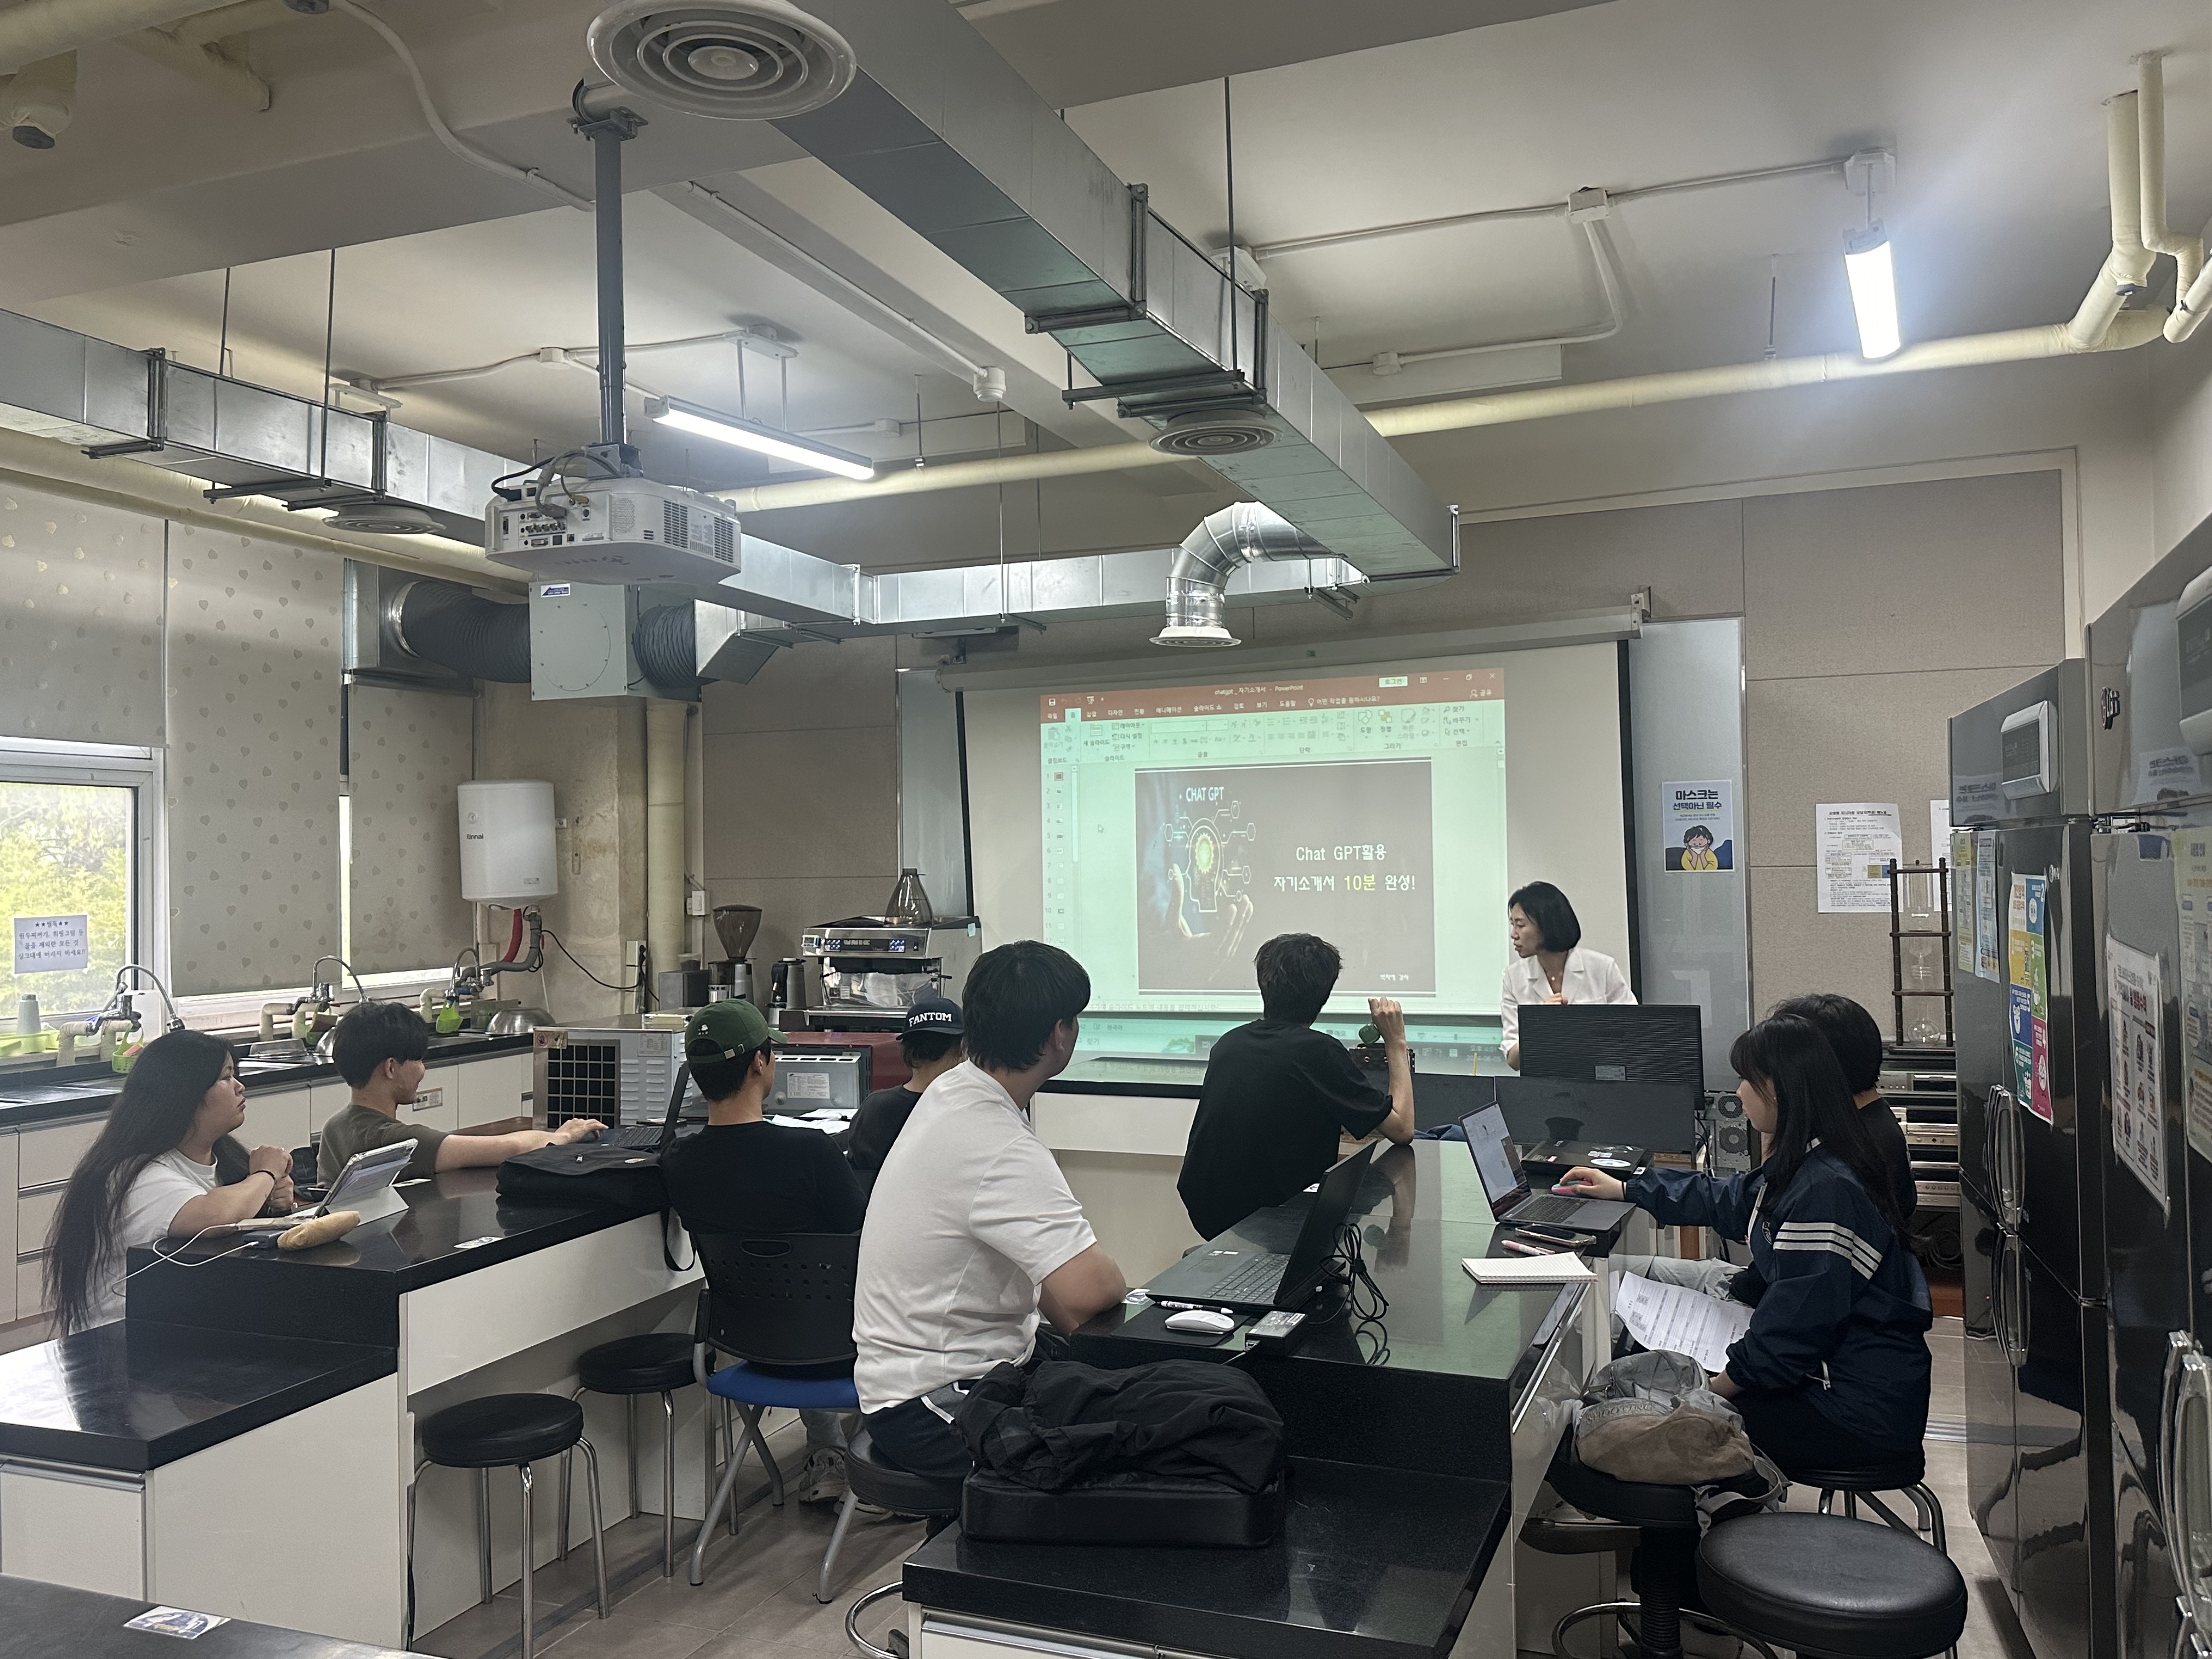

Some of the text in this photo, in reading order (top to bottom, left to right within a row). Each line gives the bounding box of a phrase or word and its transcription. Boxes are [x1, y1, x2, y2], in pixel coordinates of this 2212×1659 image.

[1186, 786, 1224, 802] CHAT GPT
[1675, 789, 1718, 800] 마스크는
[1673, 801, 1722, 810] 선택아닌 필수
[1296, 844, 1386, 861] Chat GPT활용
[1274, 874, 1415, 891] 자기소개서 10분 완성!
[909, 1012, 952, 1027] FANTOM
